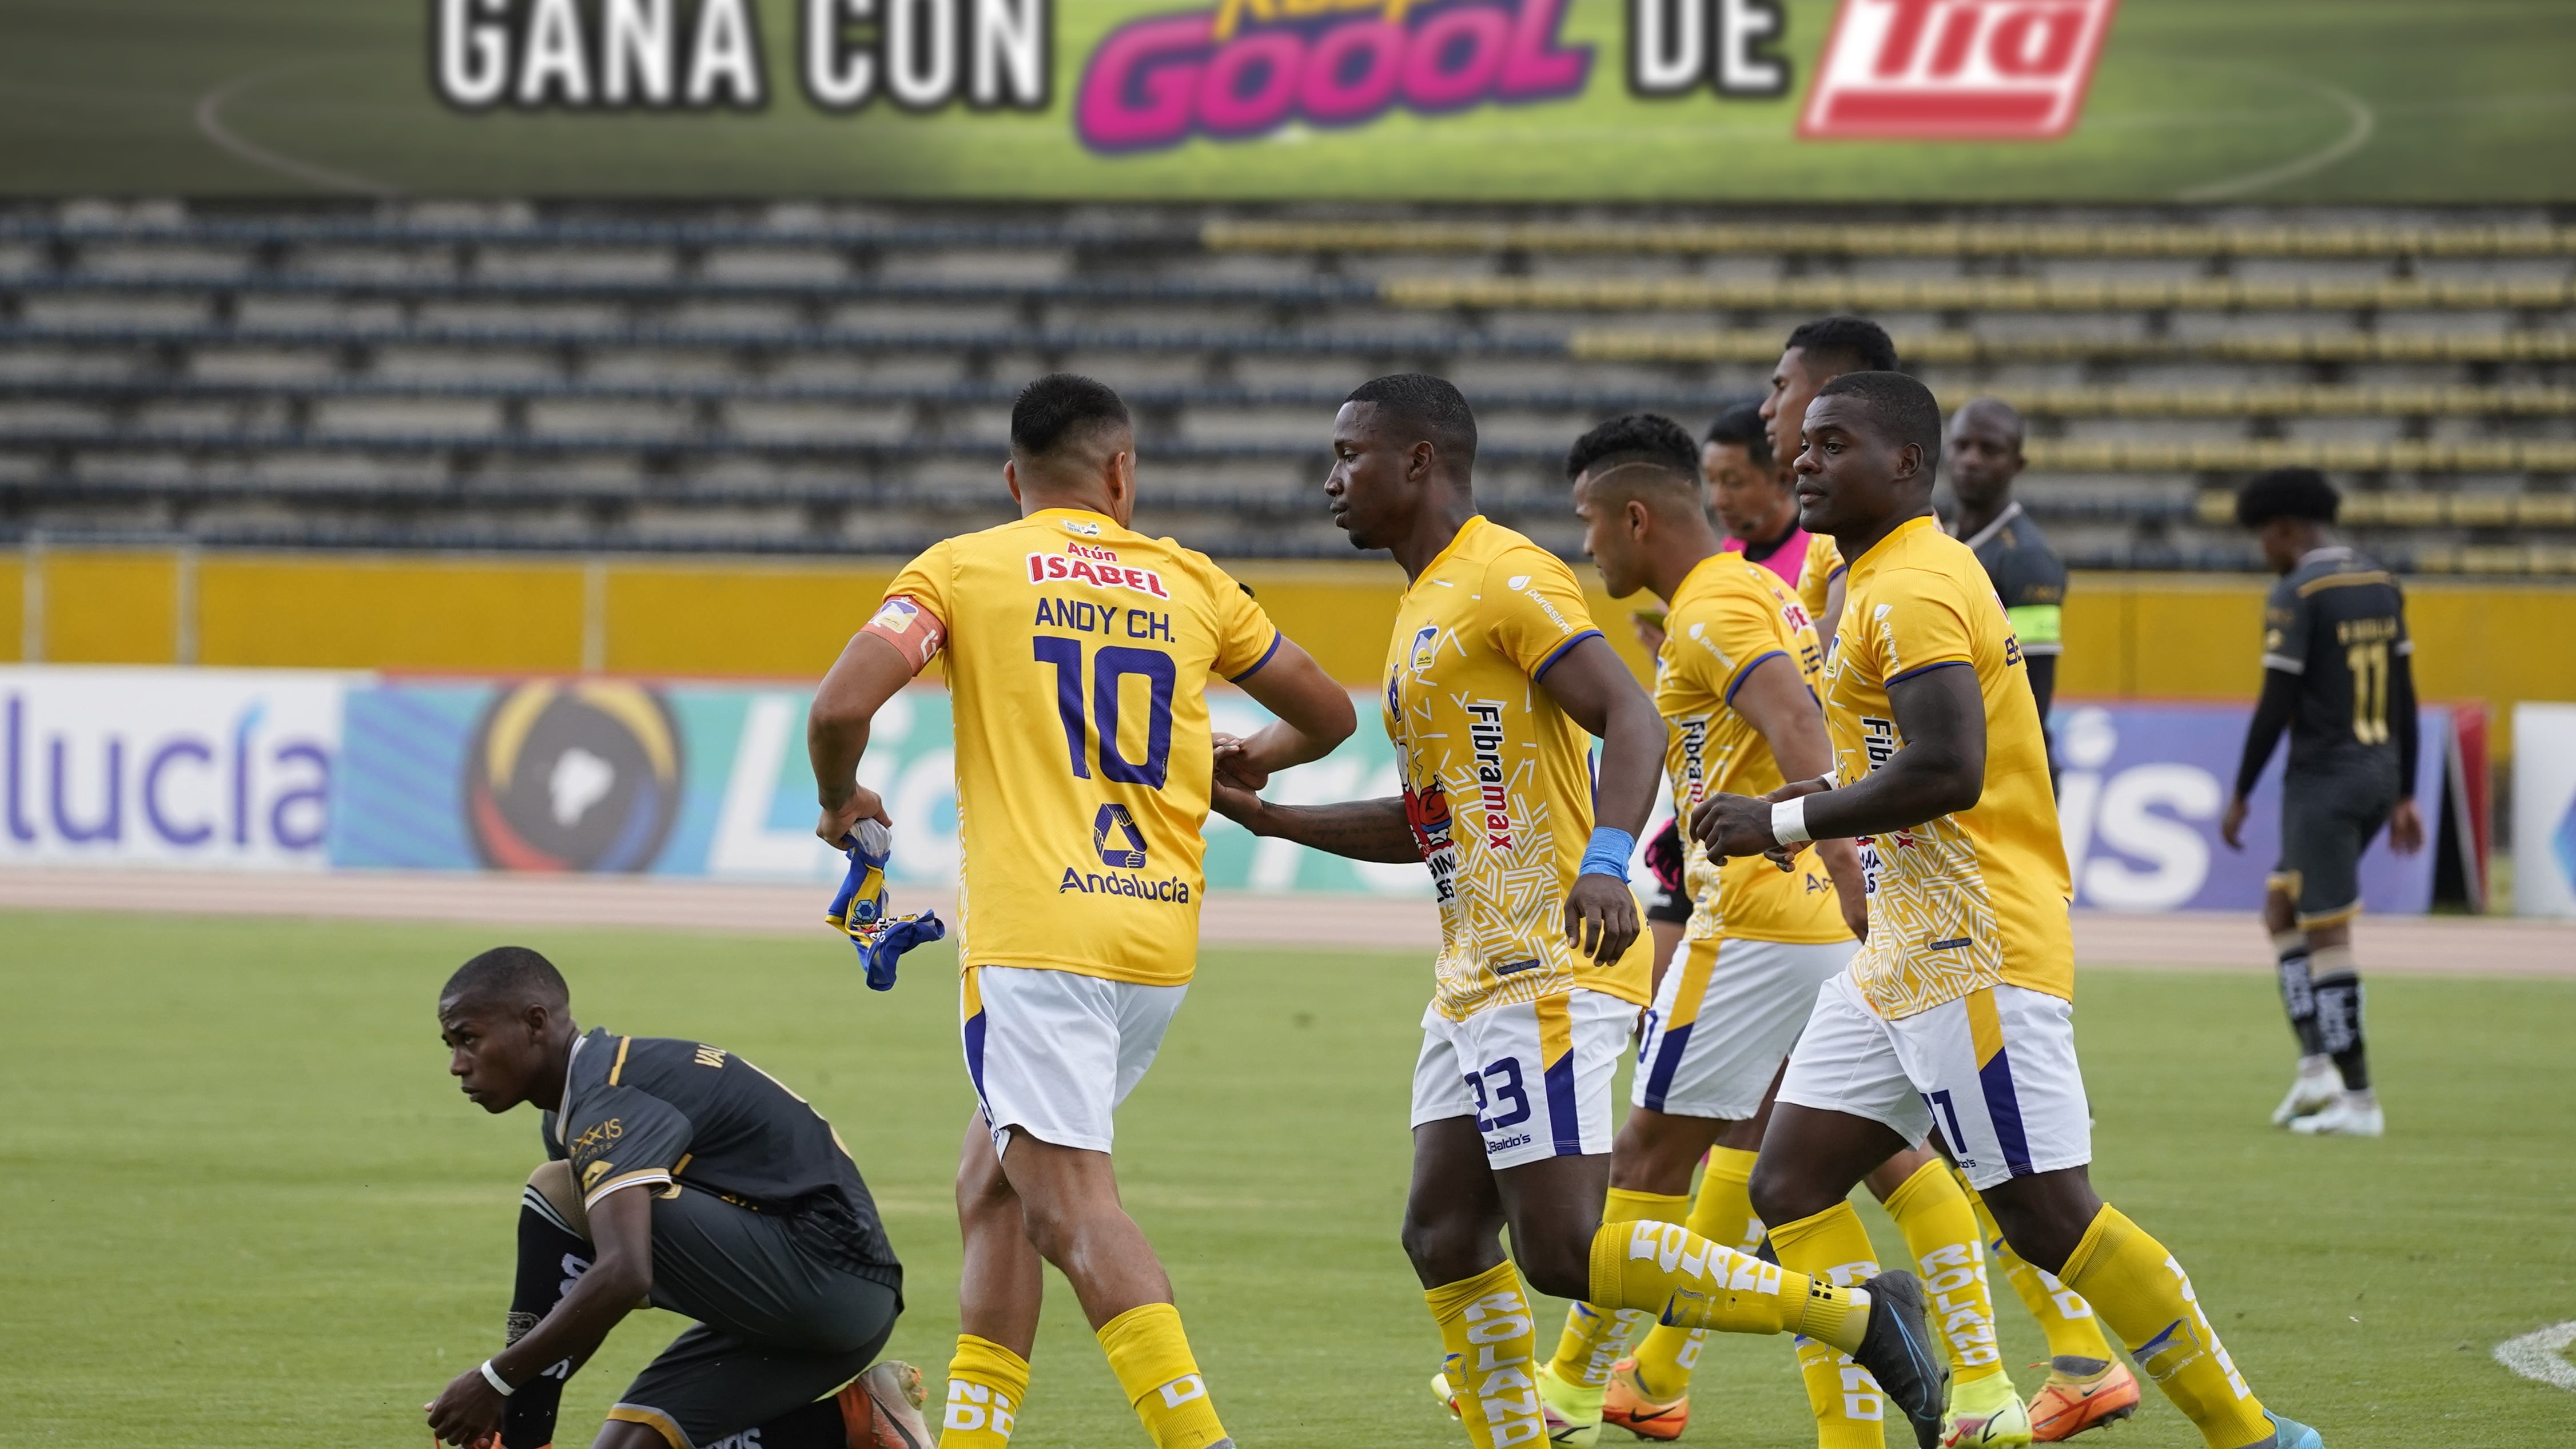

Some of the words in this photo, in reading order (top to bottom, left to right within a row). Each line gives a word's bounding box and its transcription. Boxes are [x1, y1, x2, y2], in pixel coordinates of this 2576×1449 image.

[441, 0, 758, 103] GANA
[809, 0, 1040, 103] CON
[1639, 0, 1778, 86] DE
[1030, 555, 1168, 598] ISABEL
[1068, 542, 1117, 562] Atún
[1035, 597, 1117, 635] ANDY
[1127, 609, 1176, 643] CH.
[1033, 635, 1176, 791] 10
[2346, 642, 2390, 745] 11
[1467, 703, 1513, 851] Fibramax
[1059, 866, 1189, 904] Andalucía
[1464, 1057, 1531, 1132] 23
[1630, 1219, 1782, 1296] ROLAND
[1920, 1243, 2000, 1366] ROLAND
[1463, 1291, 1540, 1449] ROLAND
